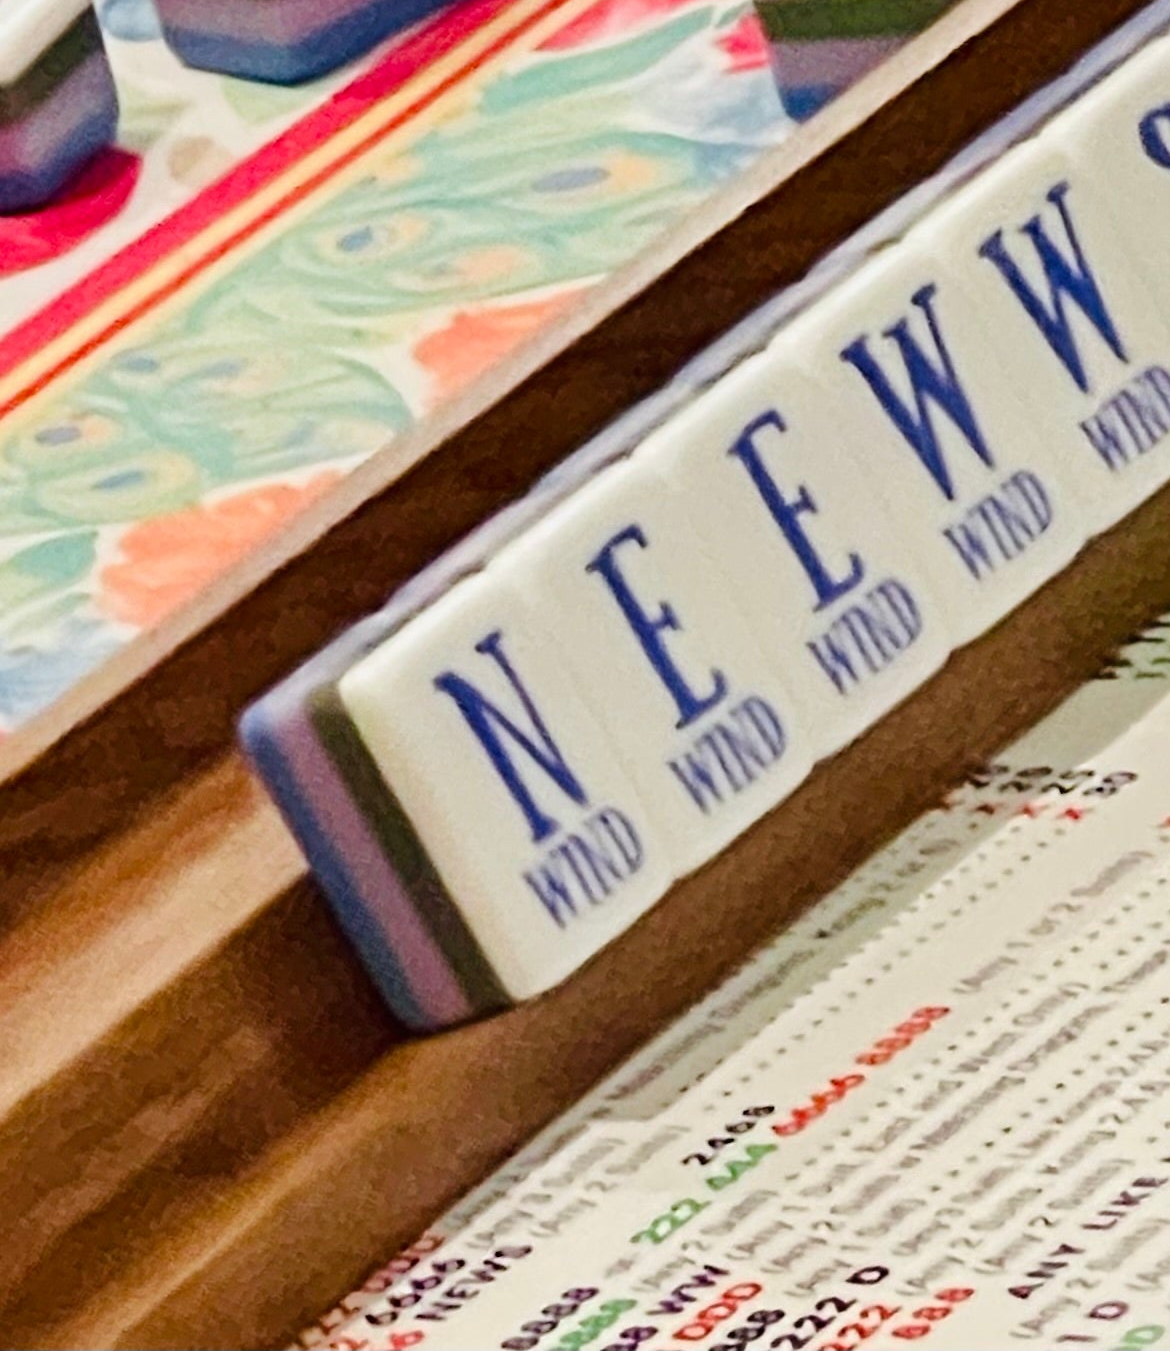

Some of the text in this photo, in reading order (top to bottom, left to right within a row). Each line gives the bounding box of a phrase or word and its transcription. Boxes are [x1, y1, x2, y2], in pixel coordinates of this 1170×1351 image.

[979, 180, 1129, 395] W
[840, 283, 994, 501] W
[729, 410, 864, 612] E
[943, 468, 1055, 582] WIND
[585, 525, 727, 730] E
[806, 577, 924, 697] WIND
[434, 630, 588, 843] N
[667, 694, 787, 816] WIND
[522, 806, 645, 930] WIND
[681, 1105, 774, 1165] 2468
[415, 1246, 532, 1321] NEWS
[845, 1265, 889, 1285] D
[1007, 1243, 1083, 1299] ANY
[1081, 1177, 1167, 1230] LIKE
[672, 1282, 762, 1341] DDD
